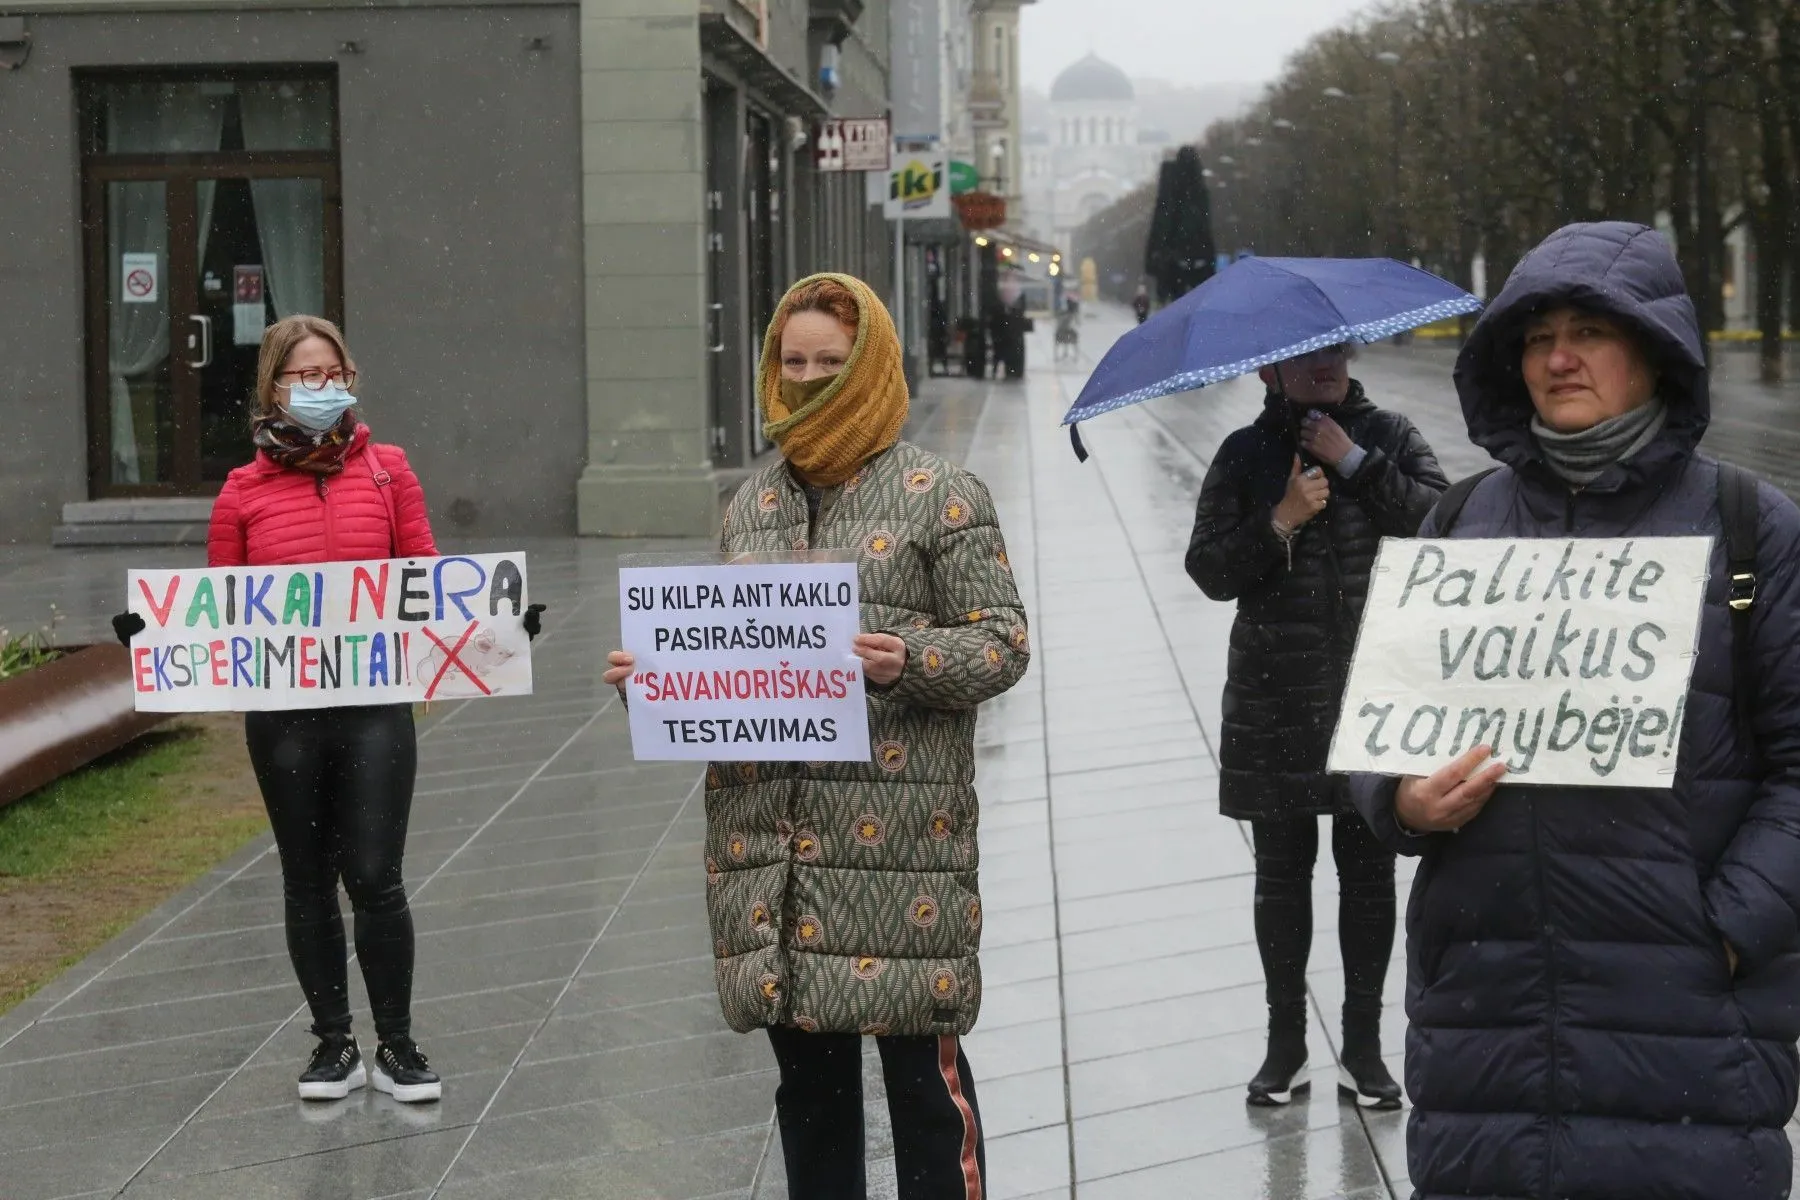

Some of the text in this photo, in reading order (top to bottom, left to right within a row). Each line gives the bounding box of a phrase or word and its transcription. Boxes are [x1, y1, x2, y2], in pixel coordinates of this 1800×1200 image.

[890, 161, 942, 200] iki
[137, 557, 523, 629] VAIKAI NĖRA
[628, 582, 851, 611] SU KILPA ANT KAKLO
[1397, 541, 1666, 609] Palikite
[655, 618, 826, 652] PASIRAŠOMAS
[1439, 608, 1667, 682] vaikus
[134, 631, 411, 693] EKSPERIMENTAI!
[663, 718, 838, 744] TESTAVIMAS
